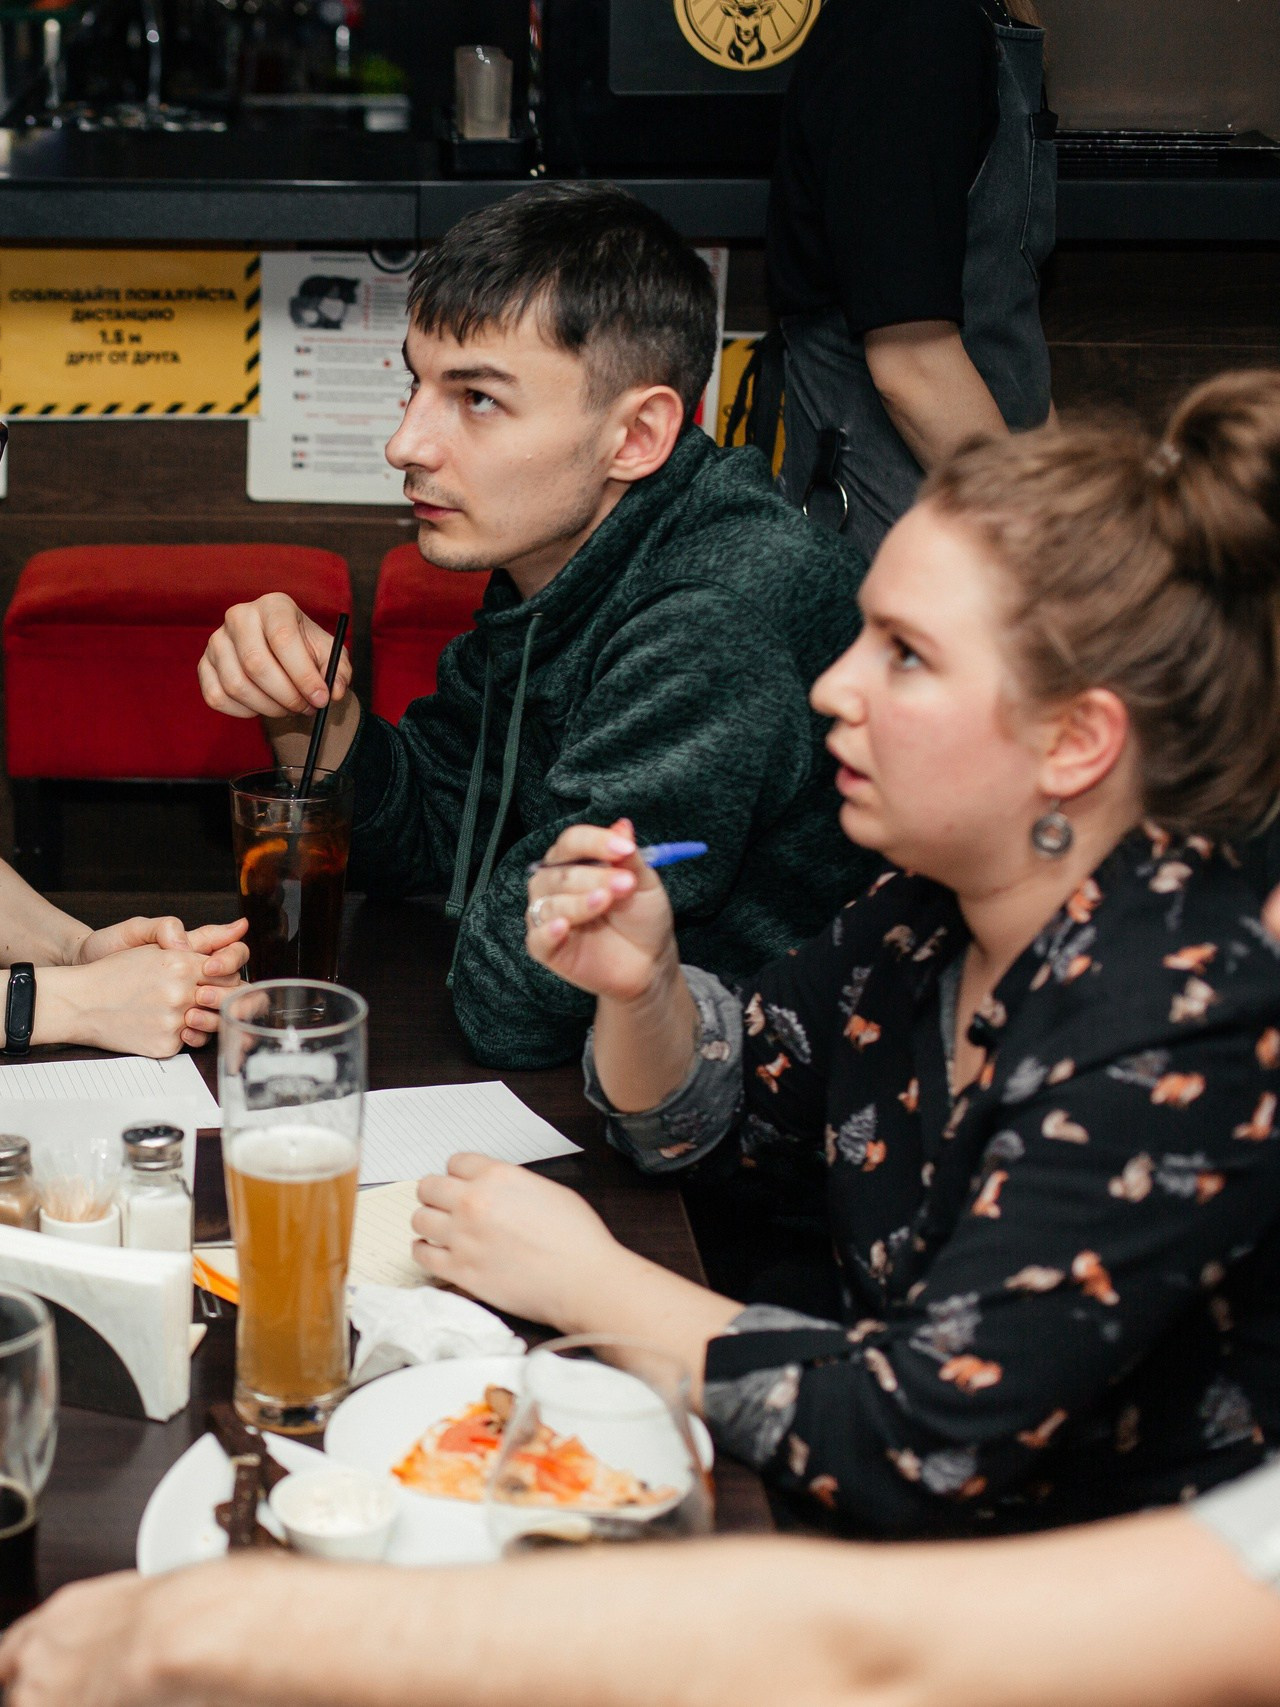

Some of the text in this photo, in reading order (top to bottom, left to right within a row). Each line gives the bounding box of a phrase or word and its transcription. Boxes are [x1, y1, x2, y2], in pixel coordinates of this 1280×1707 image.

[71, 307, 175, 322] ДИСТАНЦИЮ
[66, 352, 181, 365] ДРУГ ОТ ДРУГА
